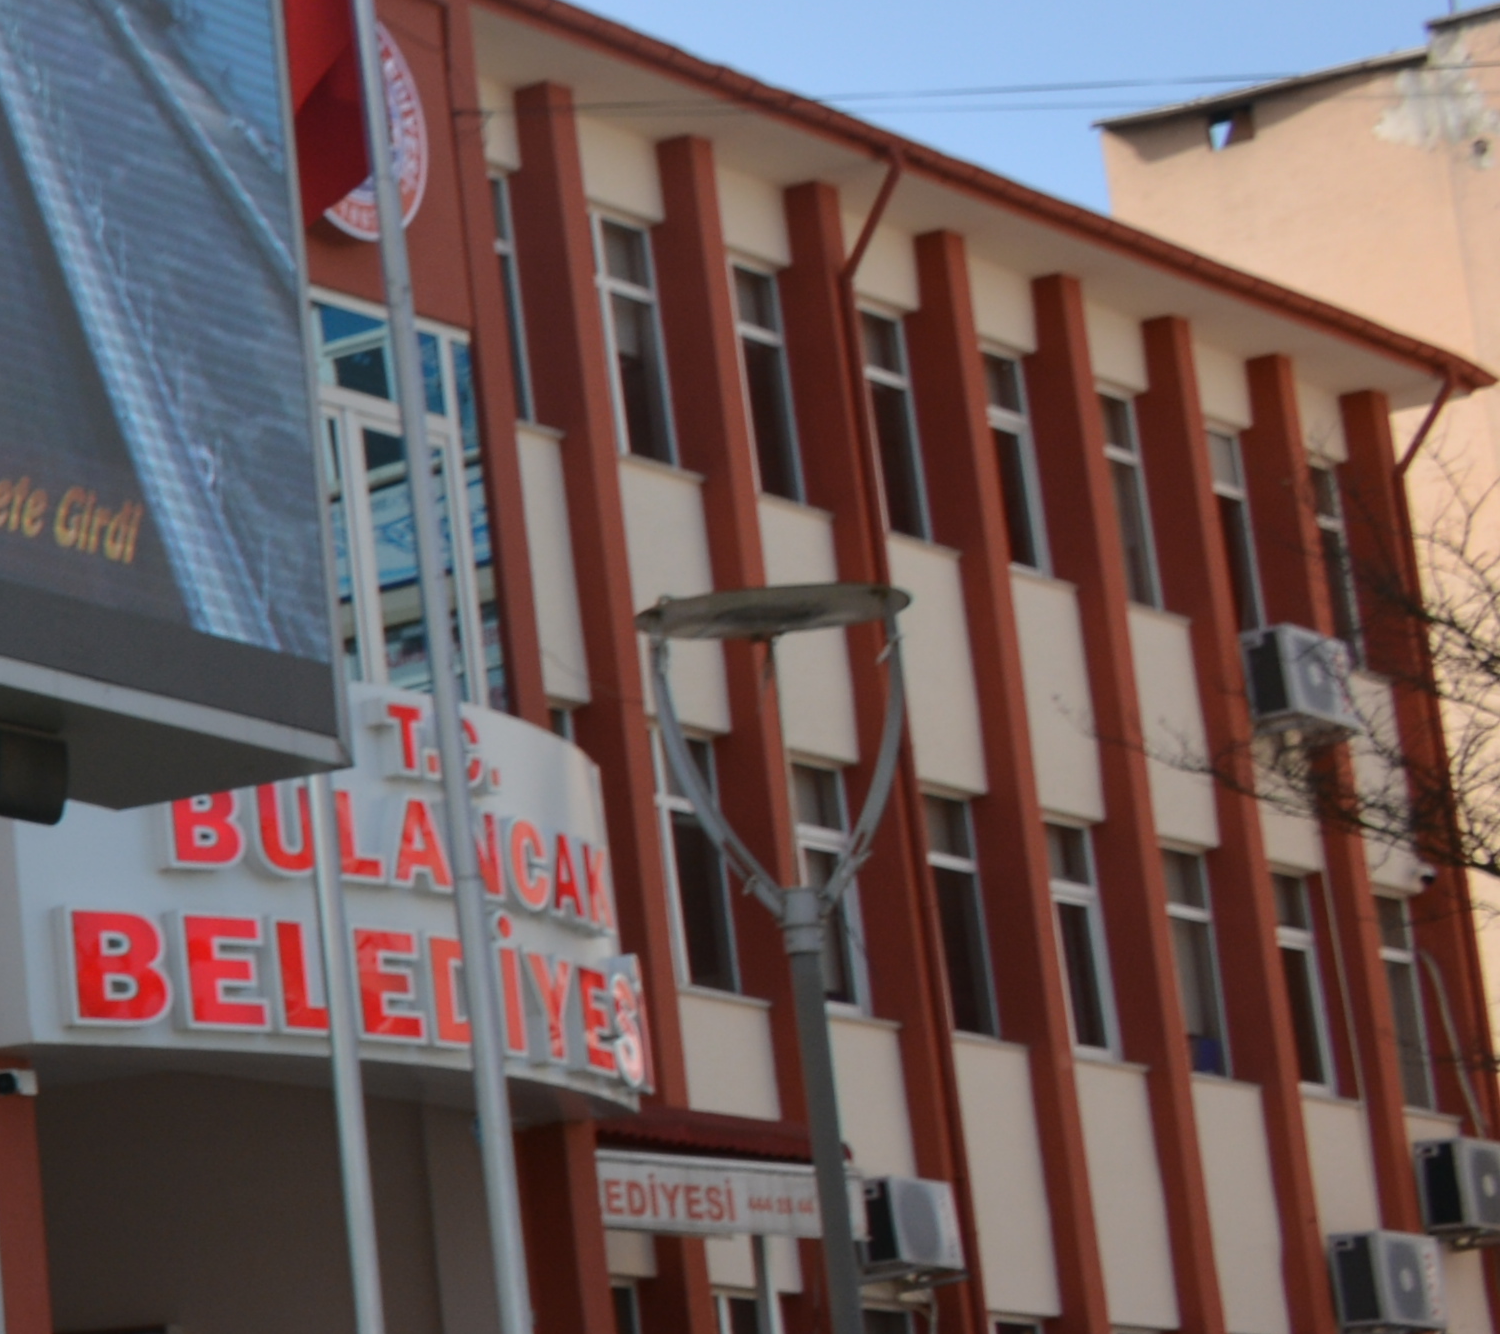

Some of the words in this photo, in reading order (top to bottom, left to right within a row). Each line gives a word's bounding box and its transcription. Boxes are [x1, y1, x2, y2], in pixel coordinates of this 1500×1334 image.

[53, 485, 143, 564] Girdi
[171, 781, 613, 929] BULANCAK
[601, 1173, 737, 1223] EDİYESİ
